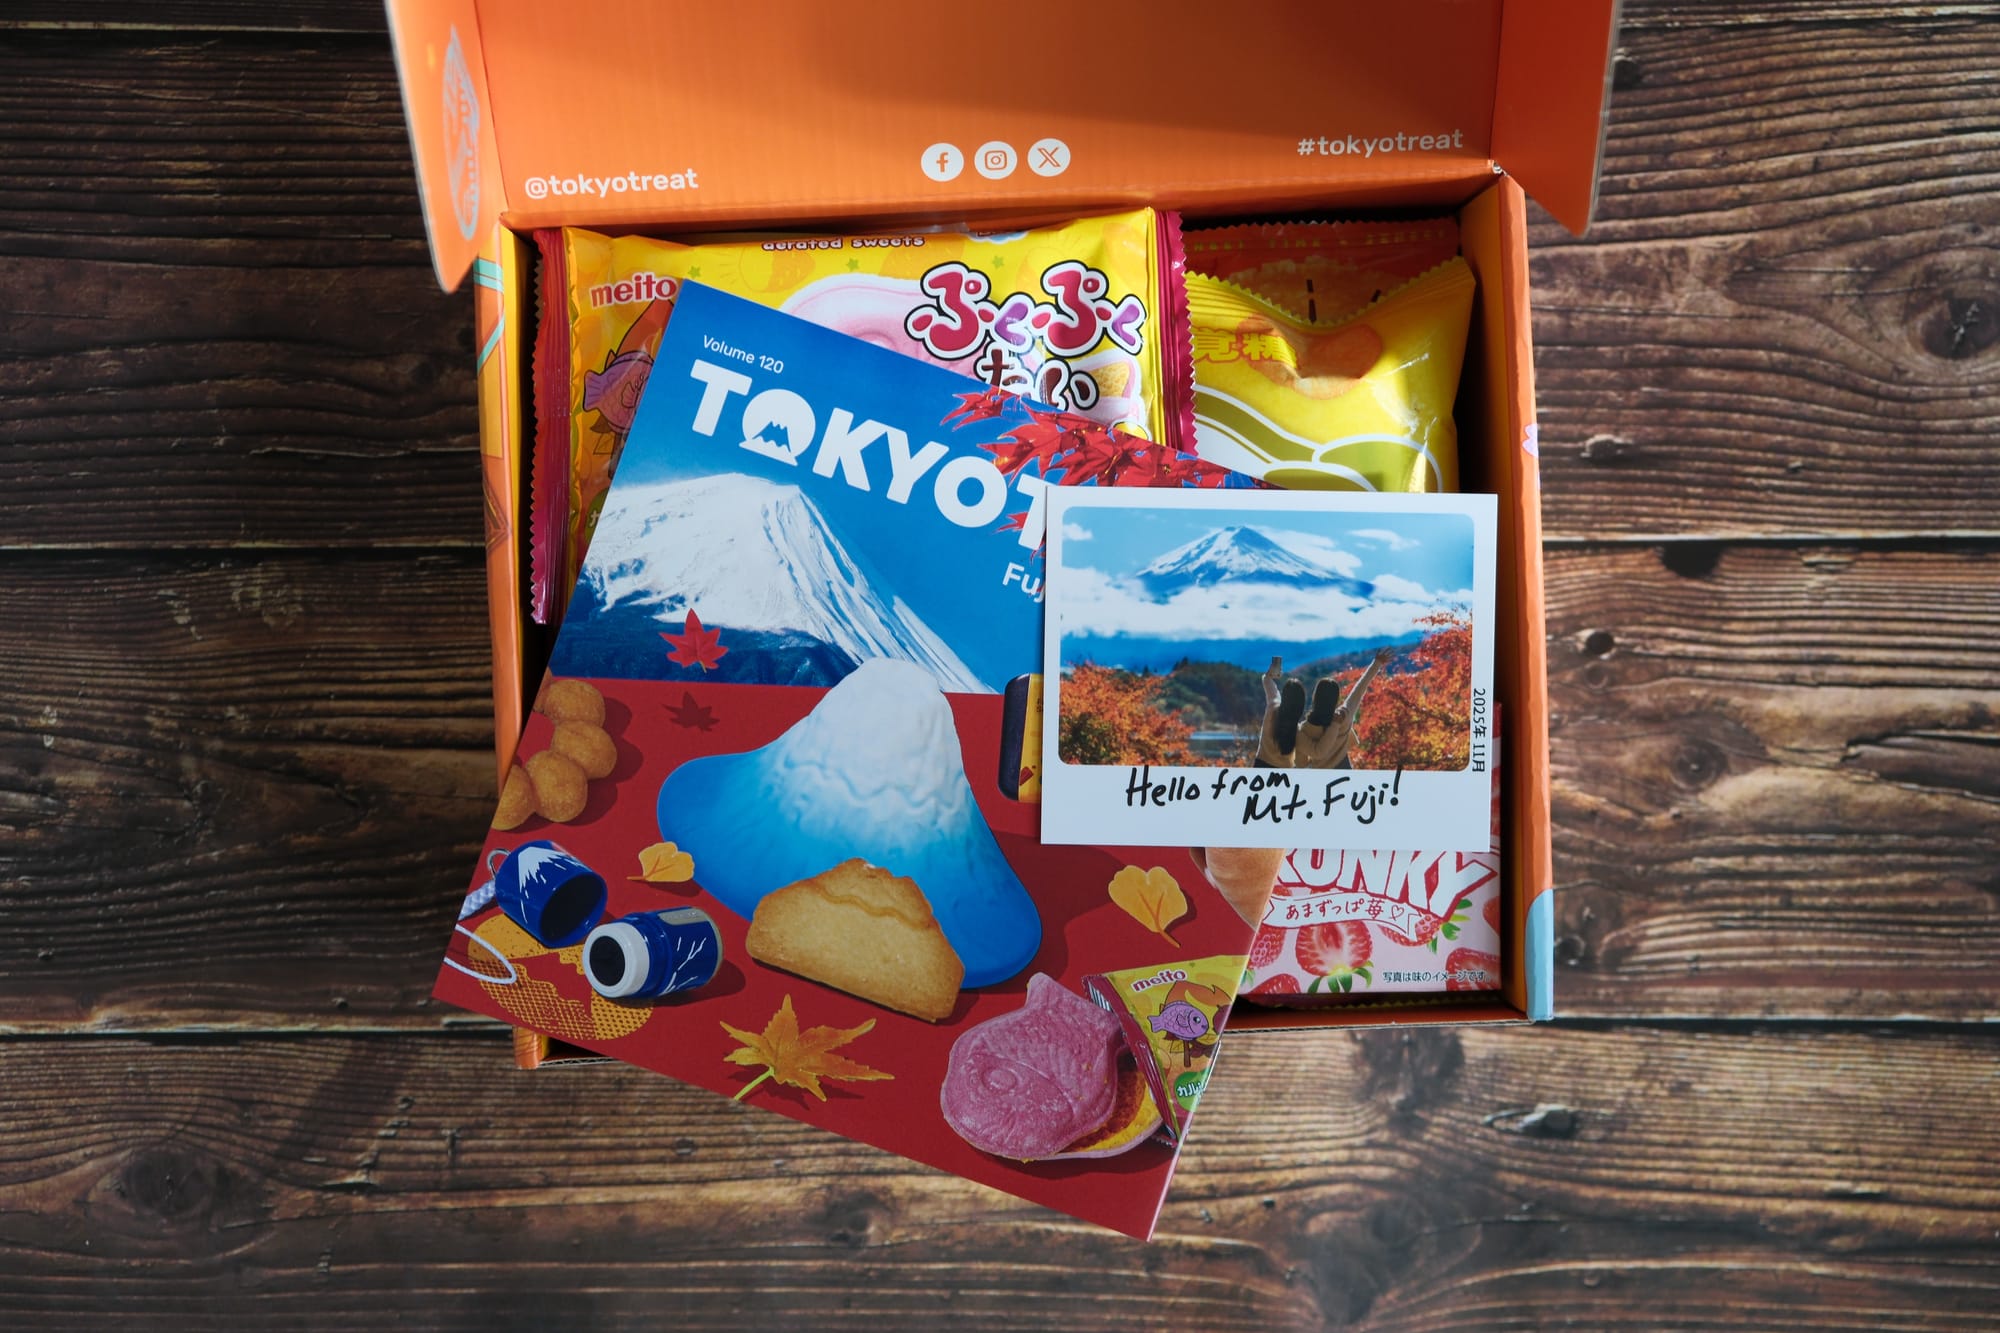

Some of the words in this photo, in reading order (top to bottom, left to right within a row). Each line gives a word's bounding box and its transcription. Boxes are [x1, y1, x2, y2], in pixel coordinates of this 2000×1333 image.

[1297, 129, 1464, 158] #tokyotreat
[525, 168, 699, 199] @tokyotreat
[762, 237, 842, 251] aerated
[851, 236, 925, 248] sweets
[589, 272, 678, 308] meito
[904, 260, 1147, 360] ぷくぷく
[703, 336, 756, 364] Volume
[759, 354, 784, 375] 120
[1473, 688, 1487, 738] 2025年
[1472, 744, 1485, 772] 11月
[1126, 765, 1200, 806] Hello
[1211, 769, 1290, 800] from
[1242, 784, 1313, 824] Mt.
[1323, 768, 1402, 824] Fuji!
[1131, 969, 1188, 992] meito
